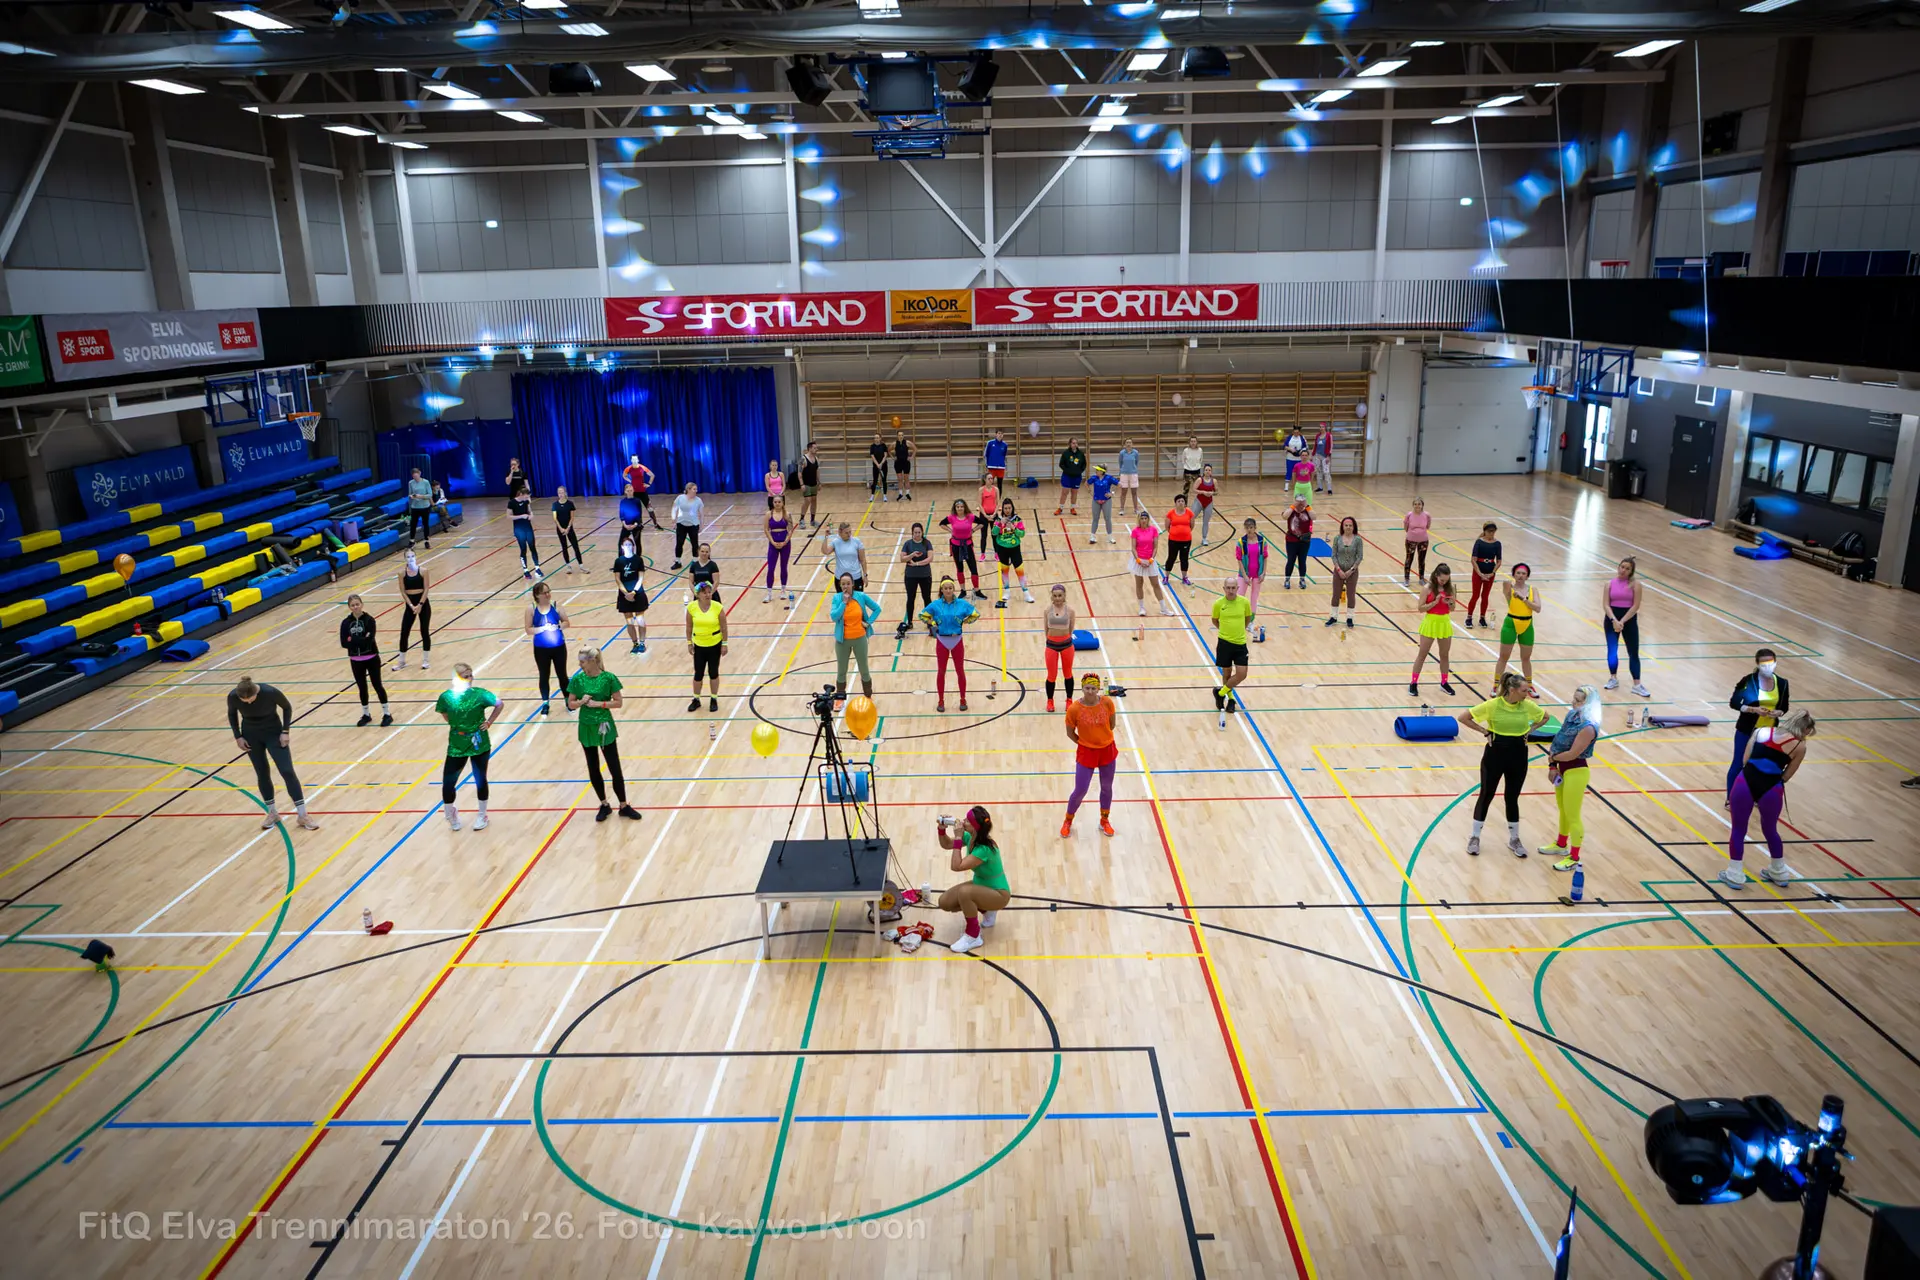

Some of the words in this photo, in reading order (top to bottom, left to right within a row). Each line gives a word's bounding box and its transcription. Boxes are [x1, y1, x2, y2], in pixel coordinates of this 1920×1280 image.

[903, 295, 959, 313] IKODOR
[1053, 289, 1239, 319] SPORTLAND
[682, 299, 867, 330] SPORTLAND
[151, 321, 184, 338] ELVA
[232, 327, 246, 336] ELVA
[77, 335, 98, 347] ELVA
[234, 335, 252, 345] SPORT
[80, 346, 105, 357] SPORT
[123, 341, 217, 363] SPORDIHOONE
[248, 444, 274, 461] ELVA
[276, 439, 302, 454] VALD
[154, 466, 185, 484] VALD
